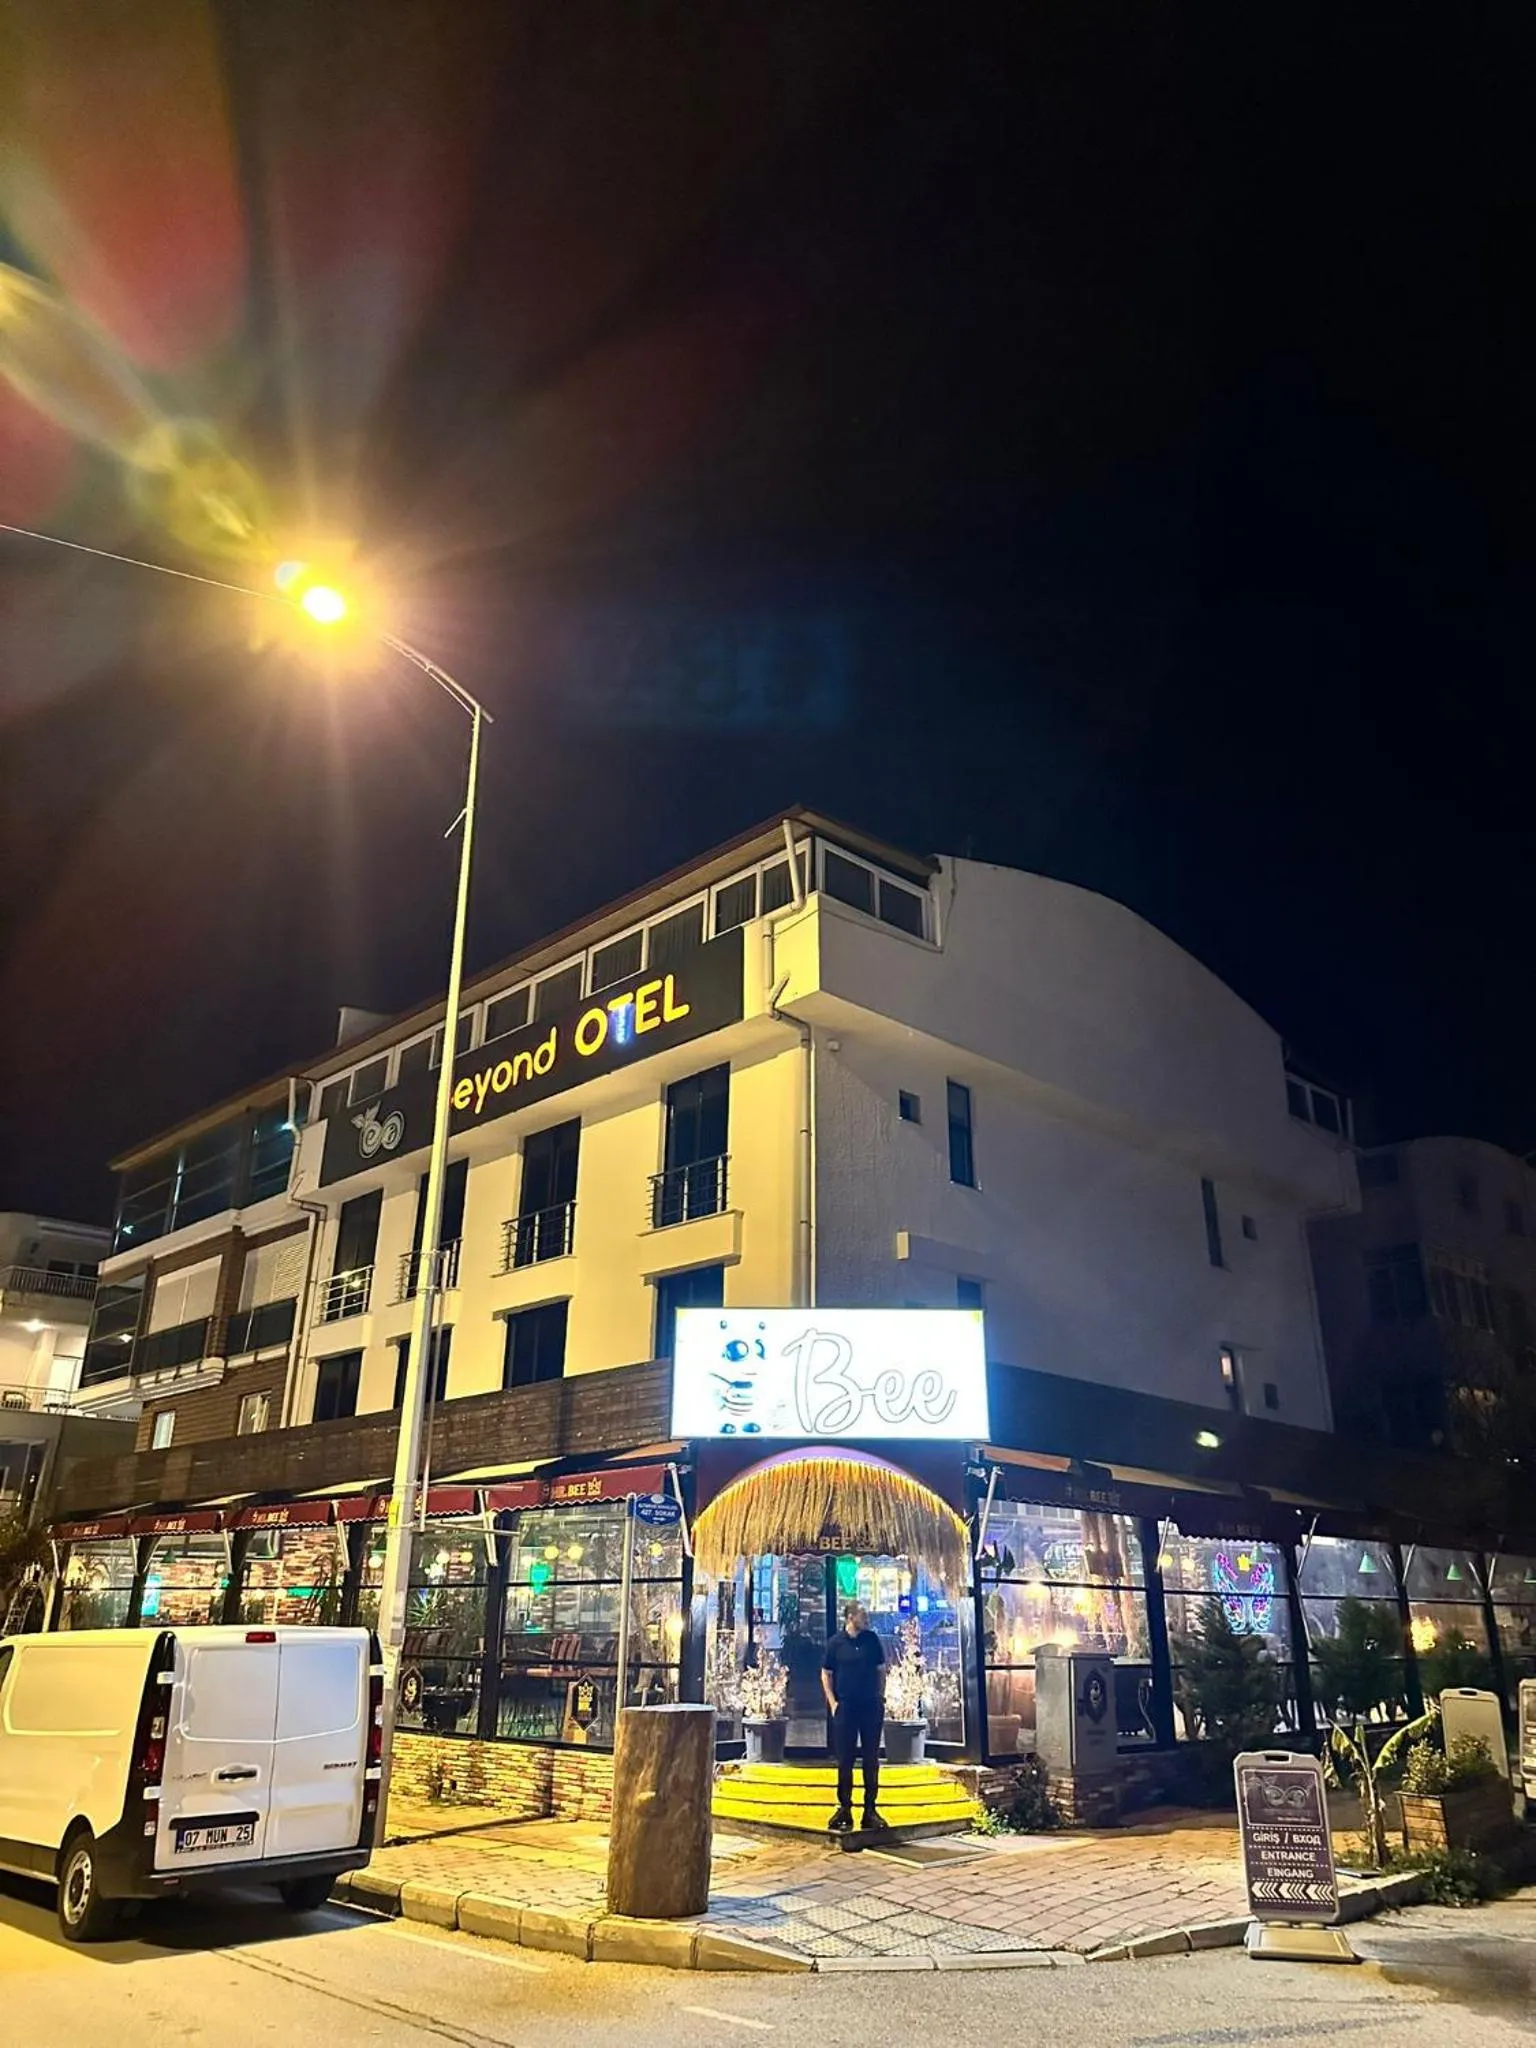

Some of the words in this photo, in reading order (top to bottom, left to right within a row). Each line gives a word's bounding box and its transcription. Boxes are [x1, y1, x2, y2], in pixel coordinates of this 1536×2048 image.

[450, 1027, 557, 1114] eyond
[575, 974, 690, 1056] OTEL
[780, 1328, 957, 1434] Bee
[185, 1831, 200, 1847] 07
[236, 1825, 250, 1841] 25
[1253, 1830, 1280, 1845] GİRİŞ
[1284, 1832, 1289, 1844] /
[1292, 1833, 1322, 1846] ВХОД
[1261, 1850, 1316, 1862] ENTRANCE
[1267, 1867, 1314, 1879] EINGANG
